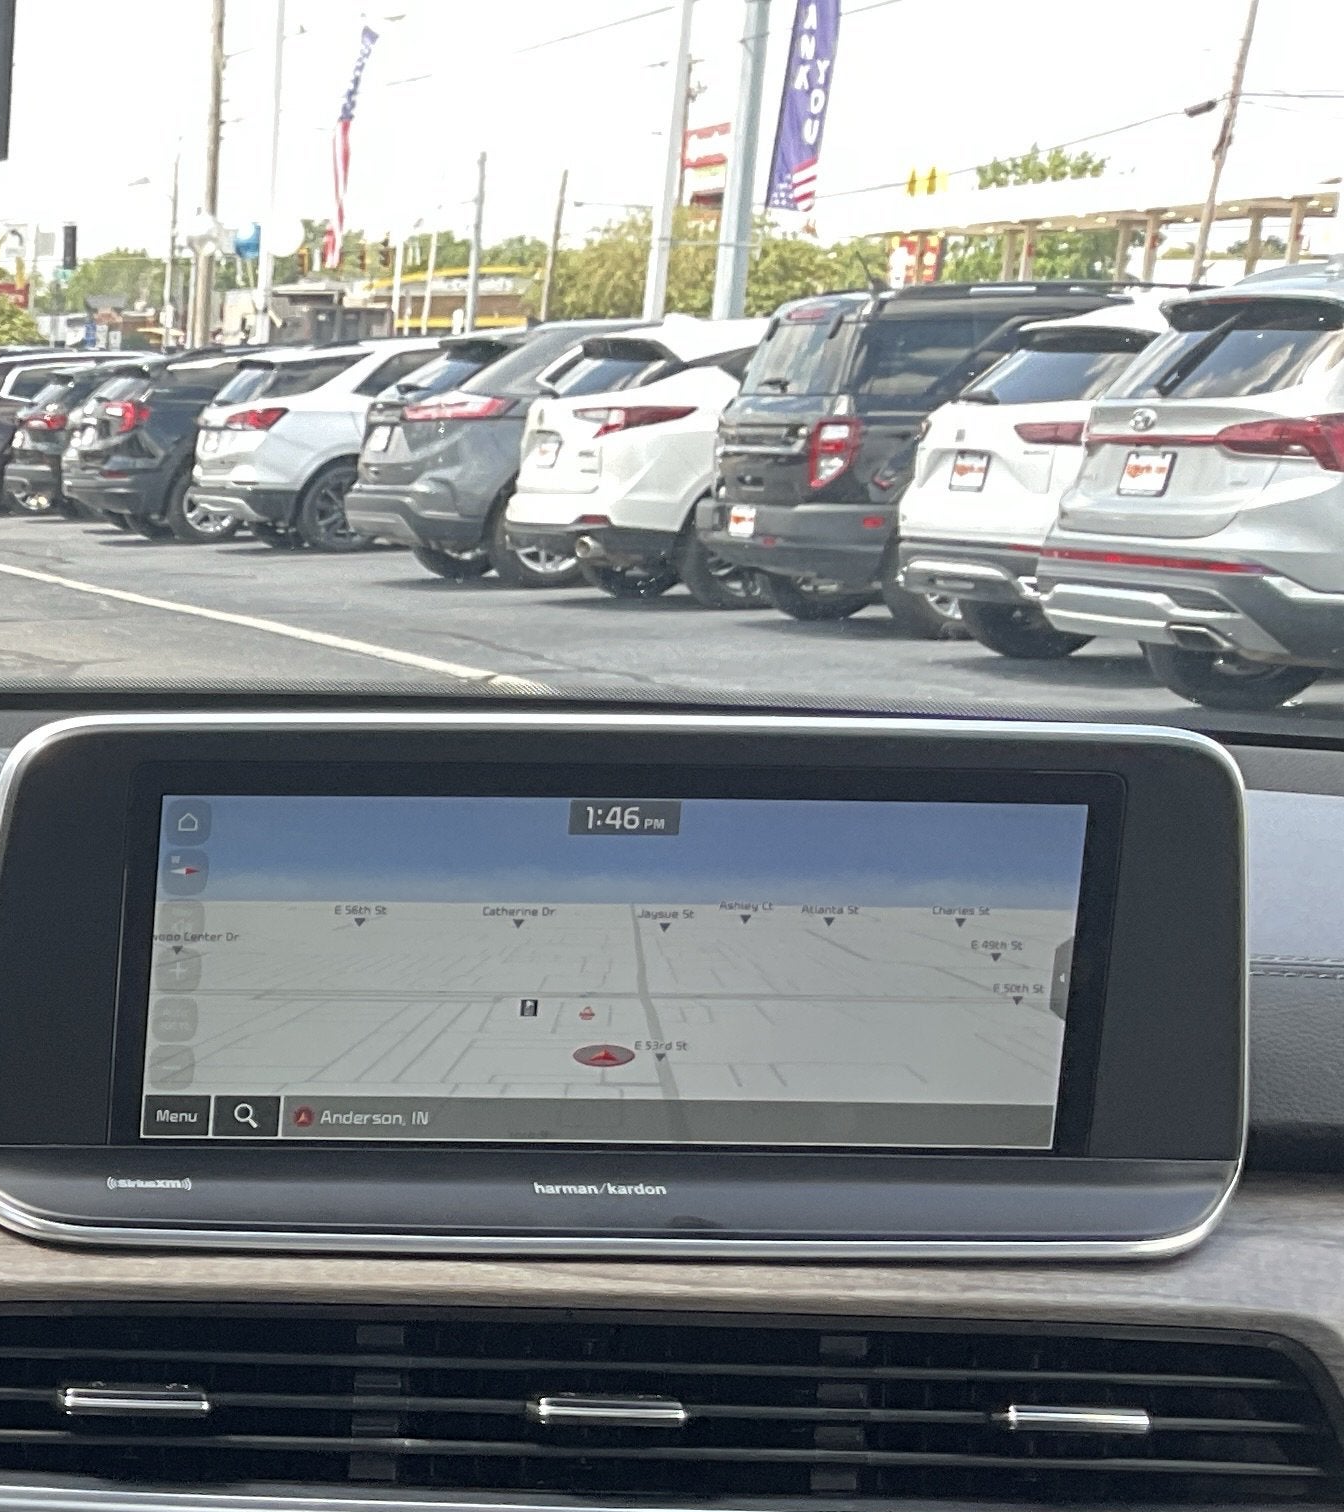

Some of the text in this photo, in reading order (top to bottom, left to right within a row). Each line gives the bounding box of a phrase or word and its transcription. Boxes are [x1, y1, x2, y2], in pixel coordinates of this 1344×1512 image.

[586, 806, 665, 830] 1:46 PM
[334, 905, 342, 915] E
[374, 905, 388, 915] St
[482, 906, 557, 917] Catherine Dr
[682, 909, 695, 919] St
[801, 905, 860, 916] Atlanta St
[932, 906, 991, 917] Charles St
[226, 932, 239, 942] Dr
[971, 940, 979, 950] E
[1011, 941, 1023, 951] St
[1033, 984, 1045, 994] St
[634, 1041, 688, 1051] E 53rd St
[156, 1109, 199, 1124] Menu
[319, 1110, 430, 1126] Anderson, IN
[533, 1181, 668, 1196] harman/kardon
